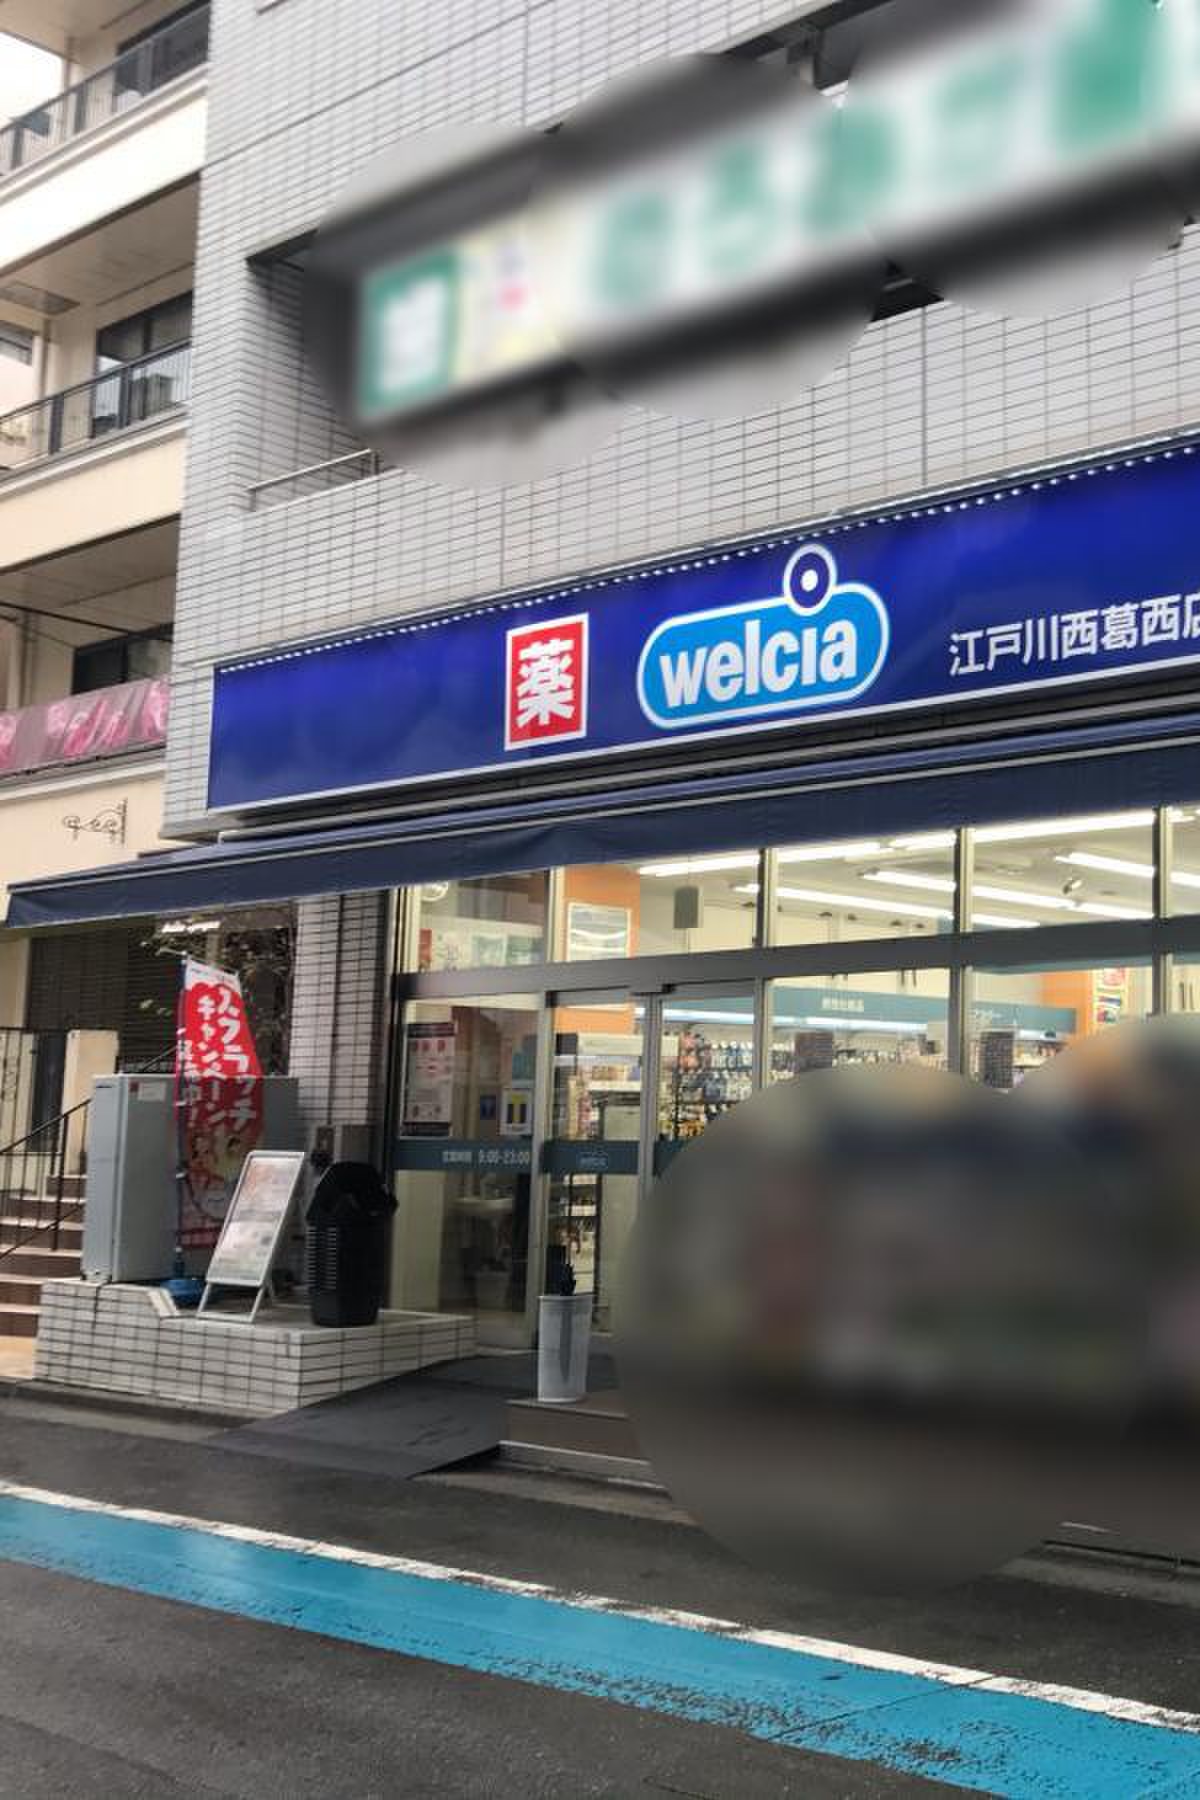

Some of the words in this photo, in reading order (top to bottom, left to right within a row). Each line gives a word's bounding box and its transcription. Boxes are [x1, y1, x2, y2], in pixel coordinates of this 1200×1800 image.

[515, 637, 576, 728] 薬
[659, 618, 858, 708] welcia
[196, 994, 227, 1125] キャンペーン
